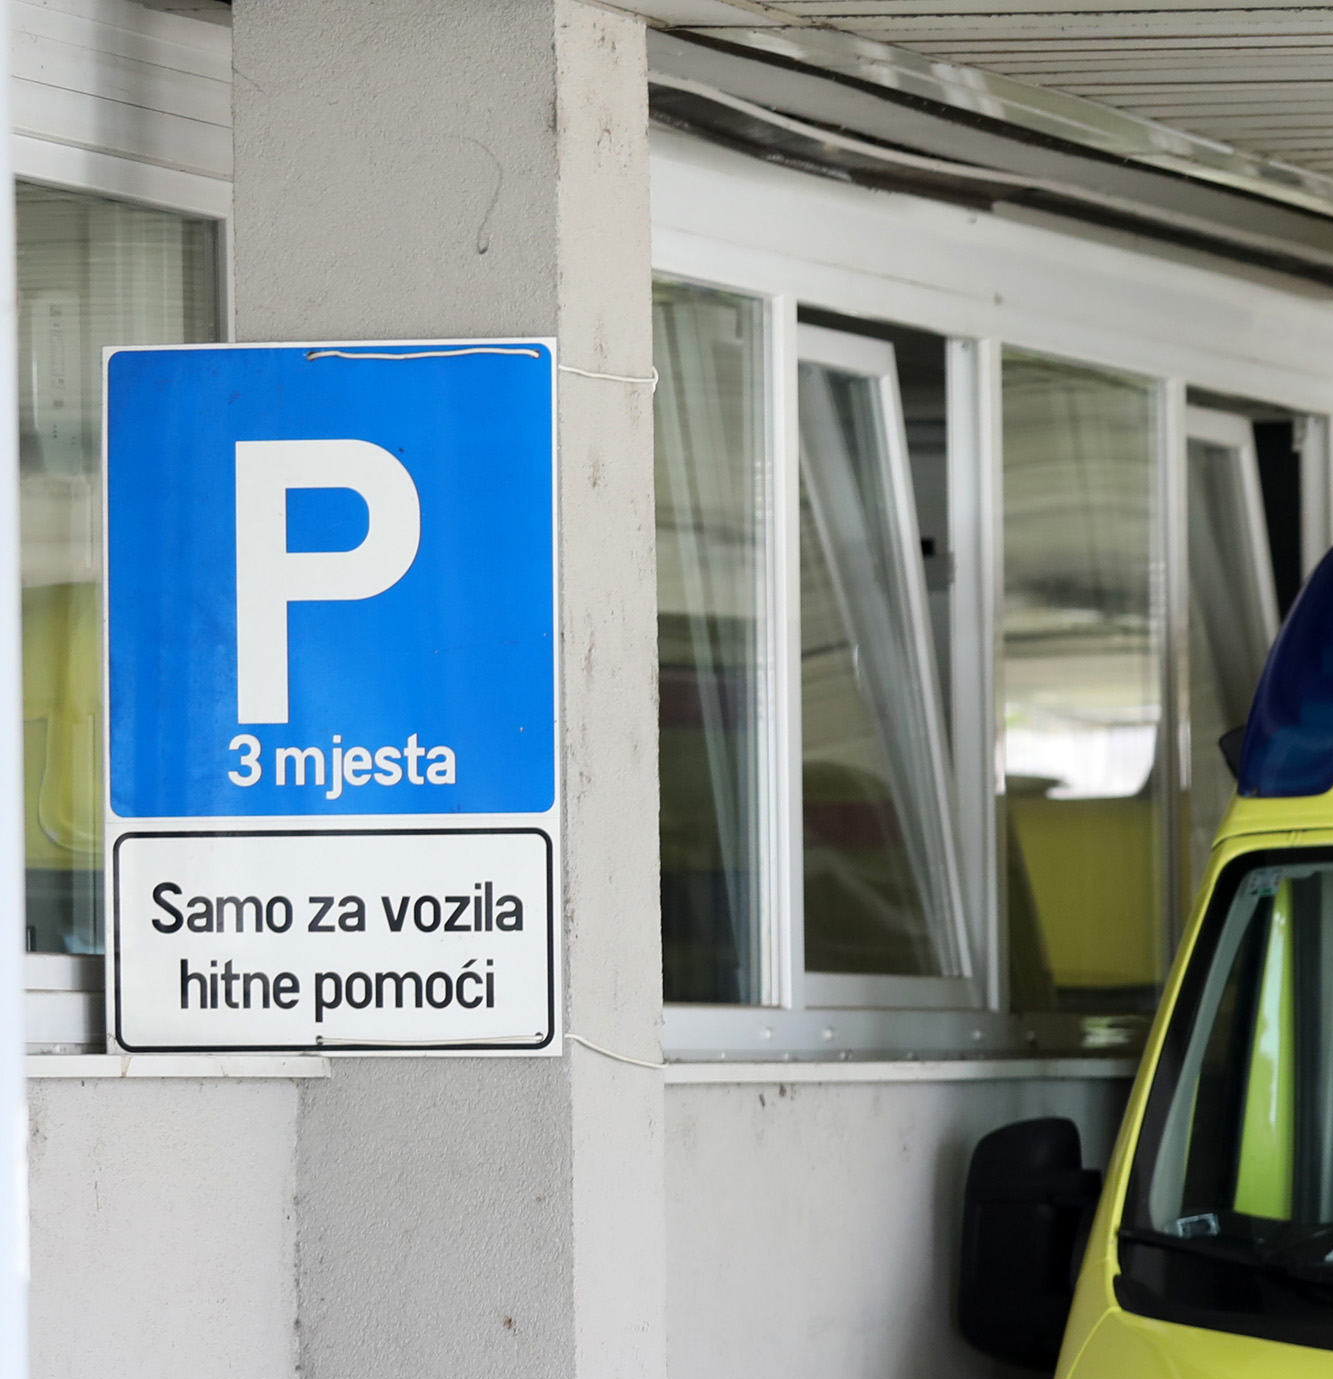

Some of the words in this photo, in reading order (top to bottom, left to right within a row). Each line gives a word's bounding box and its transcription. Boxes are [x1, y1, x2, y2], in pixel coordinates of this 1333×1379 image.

[235, 438, 421, 725] P
[227, 733, 262, 787] 3
[275, 733, 457, 800] mjesta
[151, 880, 294, 935] Samo
[307, 894, 367, 934] za
[380, 881, 525, 934] vozila
[179, 957, 301, 1011] hitne
[313, 958, 497, 1023] pomoći
